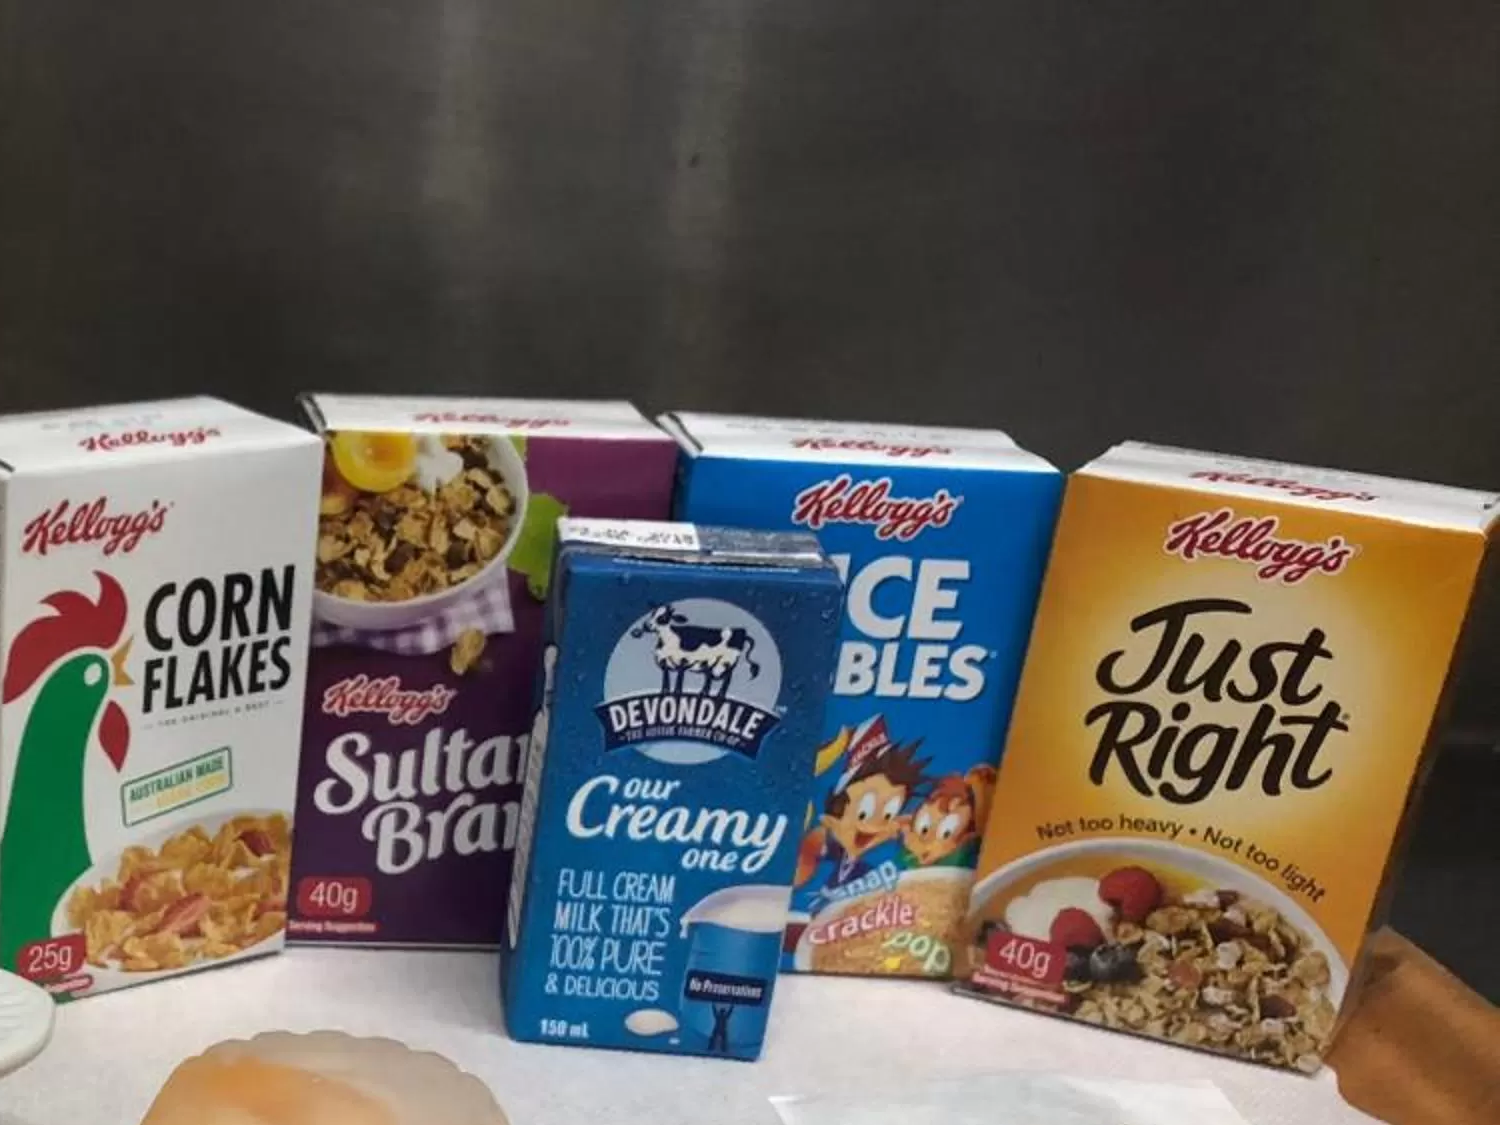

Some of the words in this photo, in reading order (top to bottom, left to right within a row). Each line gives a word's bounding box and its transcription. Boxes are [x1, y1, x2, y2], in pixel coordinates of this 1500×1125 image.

[21, 497, 169, 556] Kellogg's
[793, 474, 958, 540] Kellogg's
[1164, 506, 1352, 584] Kellogg's
[144, 564, 296, 652] CORN
[834, 553, 971, 641] CE
[141, 636, 293, 714] FLAKES
[833, 643, 989, 701] BLES
[1095, 597, 1334, 706] Just
[321, 673, 457, 726] Kellogg's
[608, 696, 765, 740] DEVONDALE
[1084, 701, 1349, 805] Right
[623, 777, 681, 800] our
[566, 774, 788, 874] Creamy
[681, 848, 738, 872] one
[1036, 819, 1075, 841] Not
[1078, 815, 1113, 832] too
[1119, 813, 1185, 842] heavy
[1202, 826, 1243, 855] Not
[1246, 841, 1280, 872] too
[1279, 861, 1326, 903] light
[308, 881, 359, 914] 40g
[557, 868, 608, 900] FULL
[612, 871, 677, 903] CREAM
[553, 902, 602, 933] MILK
[610, 905, 671, 938] THAT'S
[808, 894, 914, 946] crackle
[26, 942, 73, 975] 25g
[550, 934, 600, 971] 100%
[599, 938, 668, 977] PURE
[998, 938, 1052, 979] 40g
[544, 972, 559, 995] &
[563, 974, 660, 1001] DELICIOUS
[540, 1018, 567, 1036] 150
